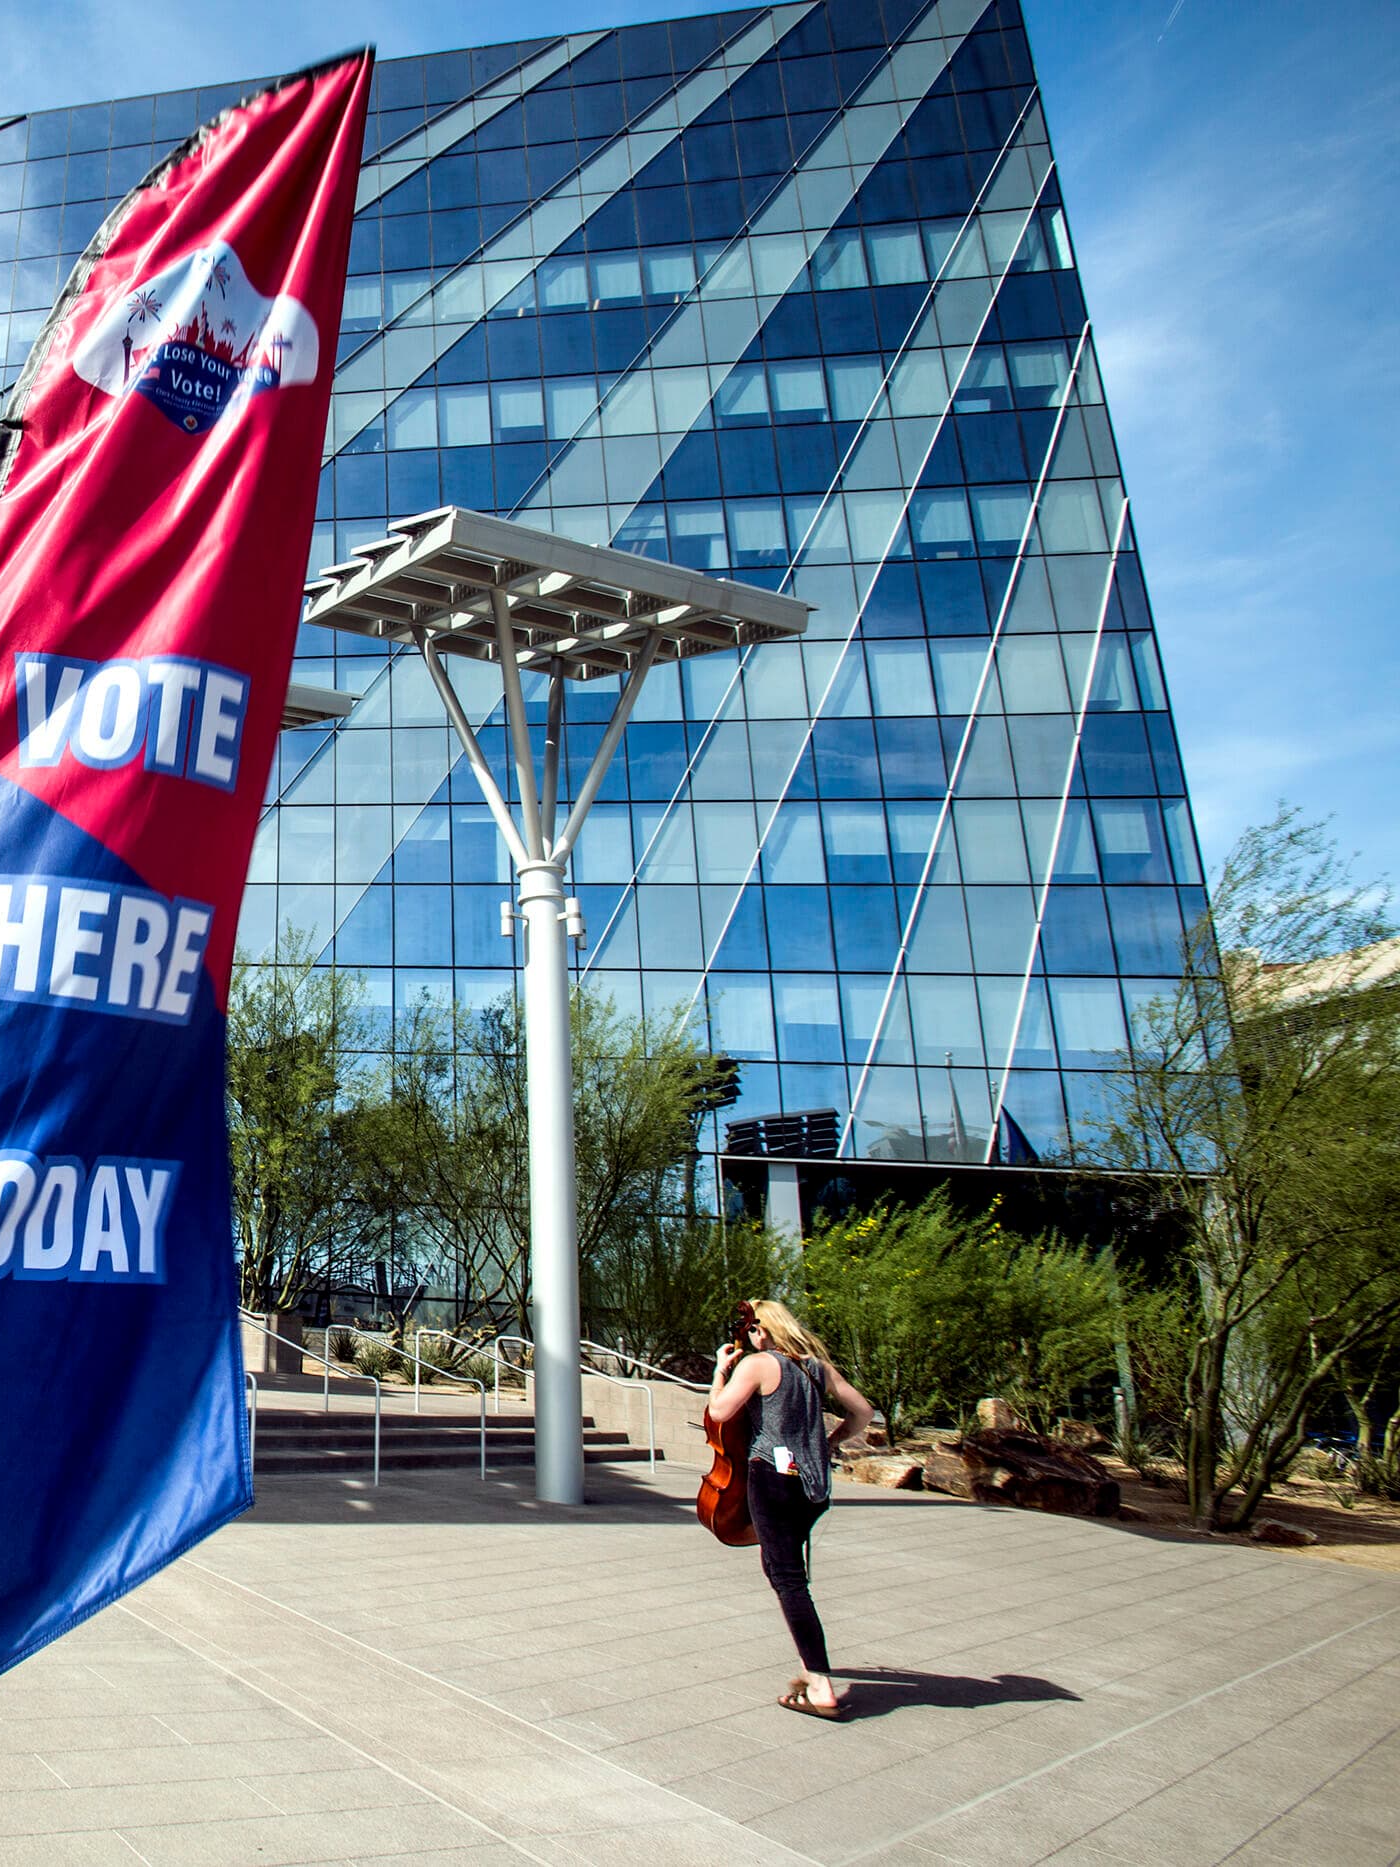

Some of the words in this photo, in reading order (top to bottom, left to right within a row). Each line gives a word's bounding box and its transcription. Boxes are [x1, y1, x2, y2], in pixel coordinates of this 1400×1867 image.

[164, 344, 196, 365] Lose
[200, 352, 231, 380] Your
[171, 368, 221, 403] Vote!
[23, 661, 245, 782] VOTE
